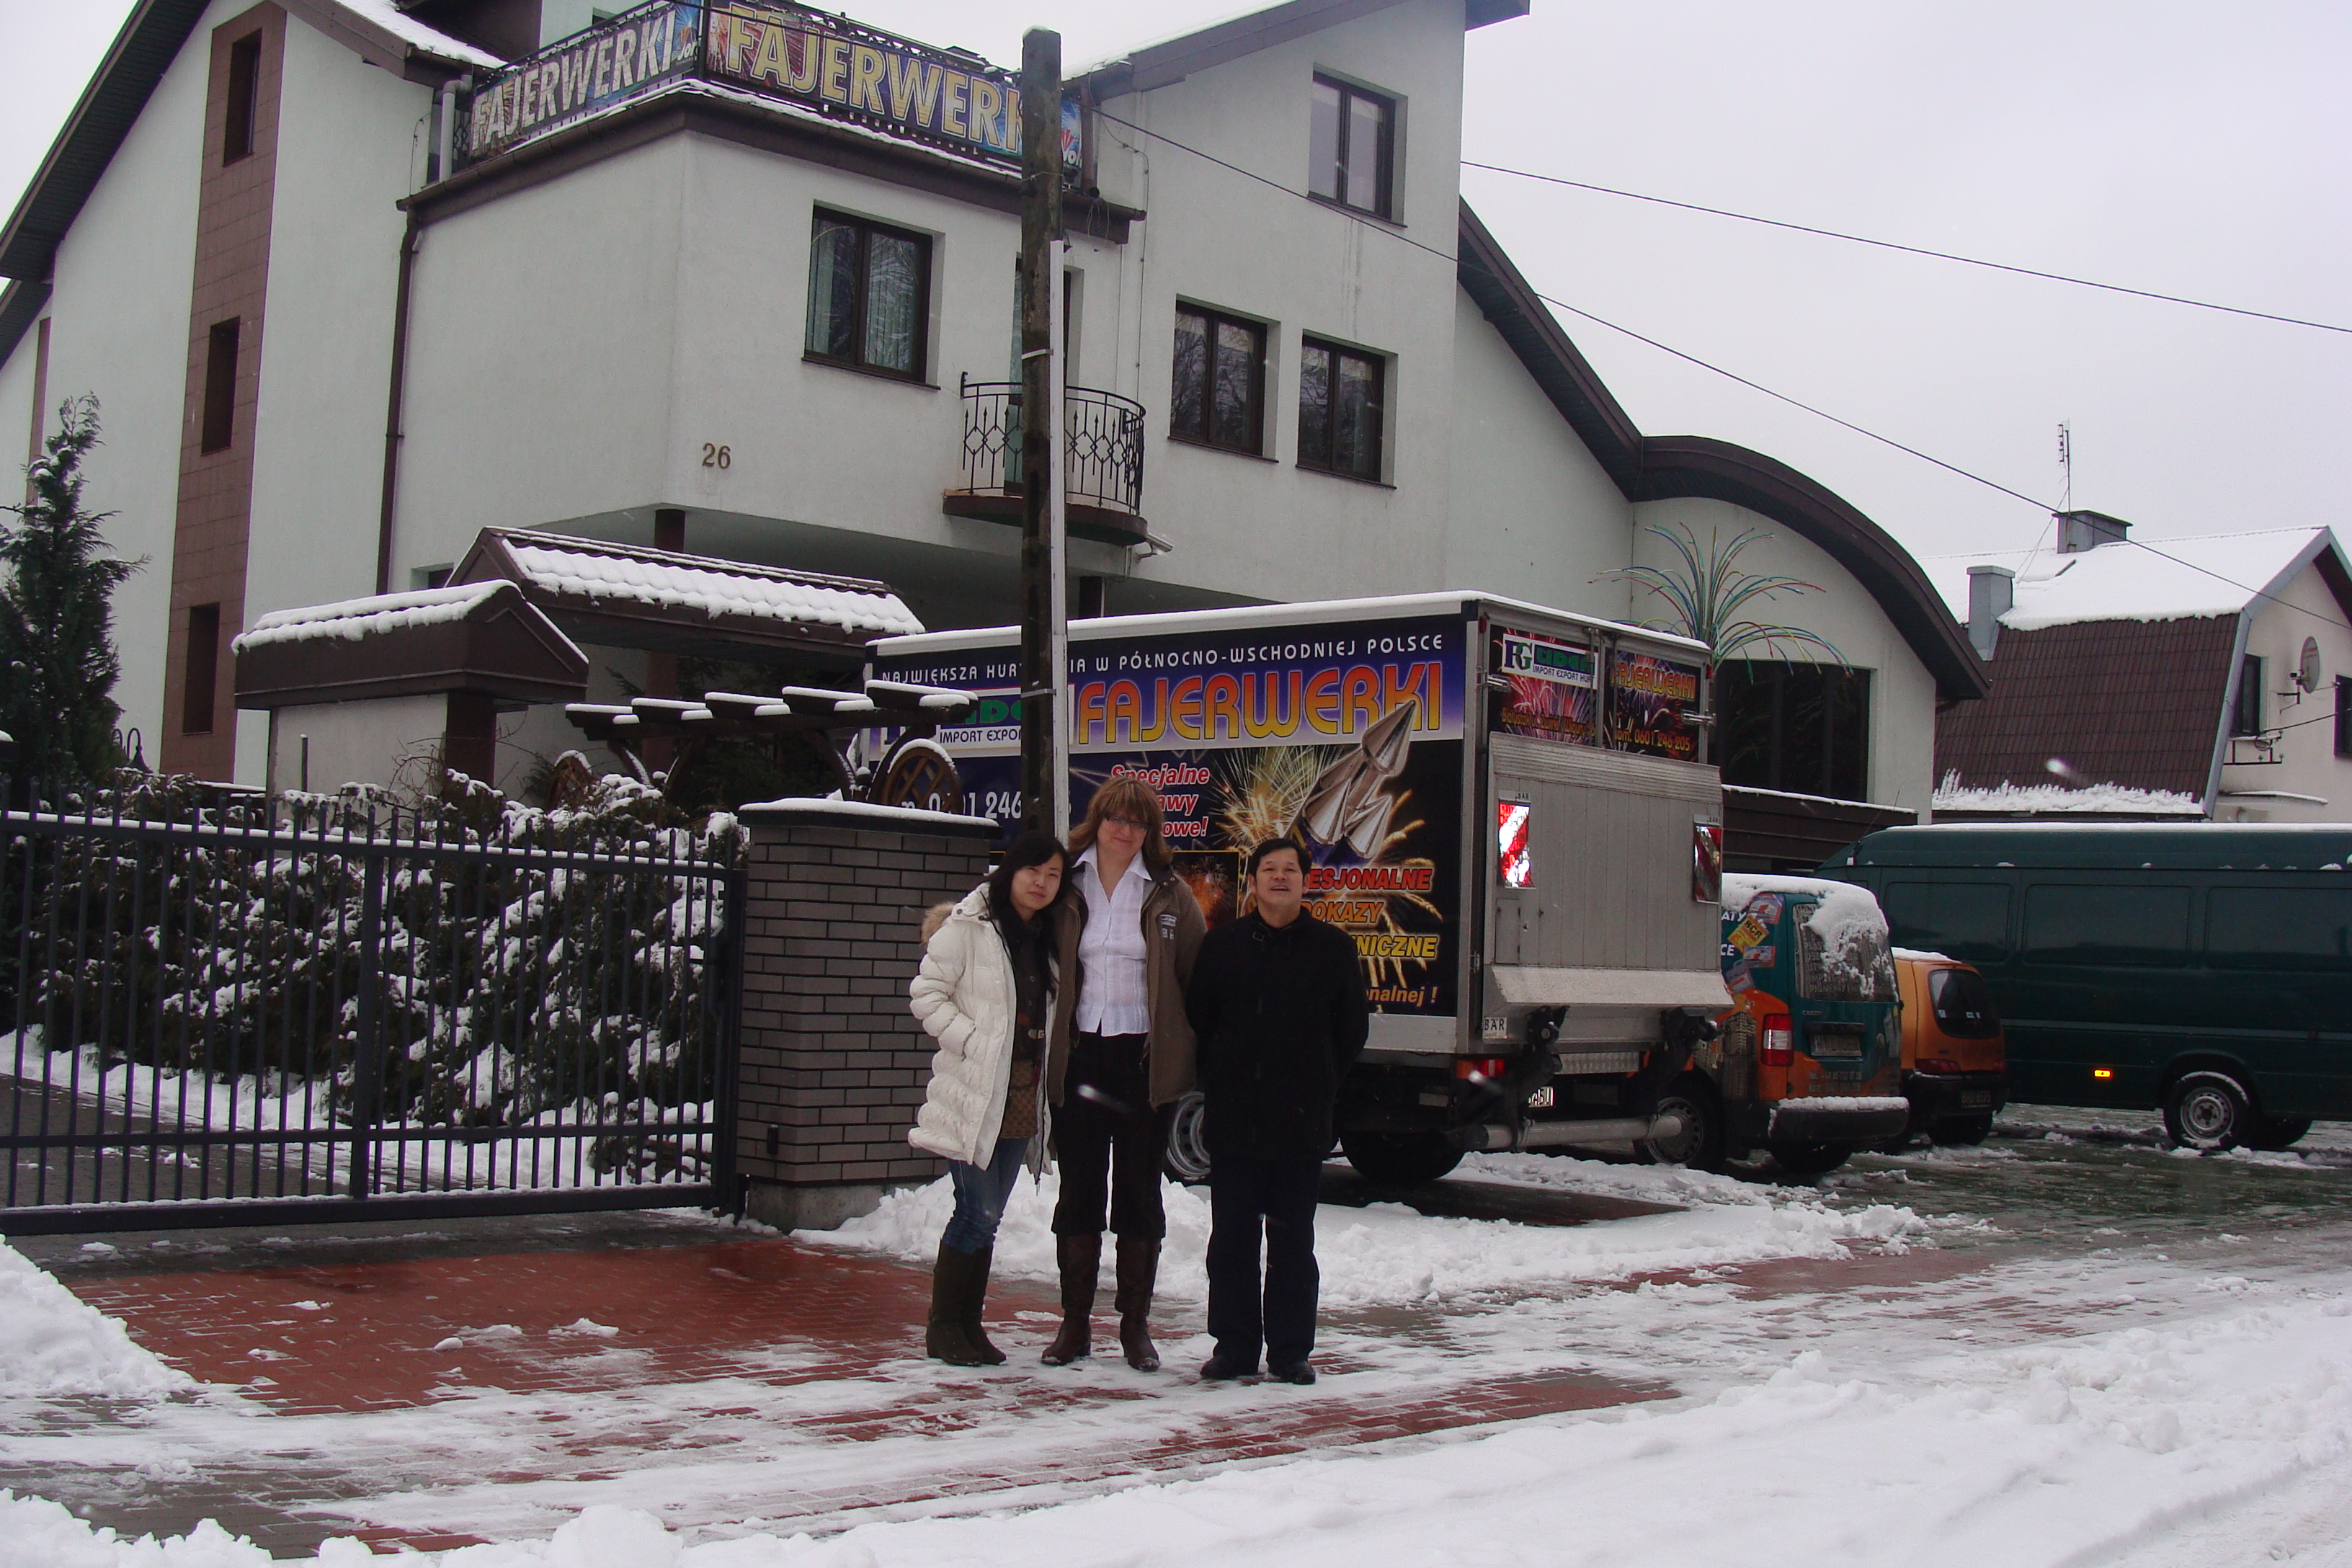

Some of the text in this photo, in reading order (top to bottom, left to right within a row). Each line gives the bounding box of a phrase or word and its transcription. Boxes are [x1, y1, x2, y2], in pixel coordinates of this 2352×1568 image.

[472, 9, 676, 151] FAJERWERKI
[702, 442, 731, 469] 26
[1095, 656, 1109, 672] W
[1367, 633, 1442, 654] POLSCE
[1533, 664, 1555, 677] IMPORT
[1556, 669, 1579, 682] EXPORT
[1078, 662, 1441, 745] FAJERWERKI
[940, 728, 1022, 744] IMPORT EXPO
